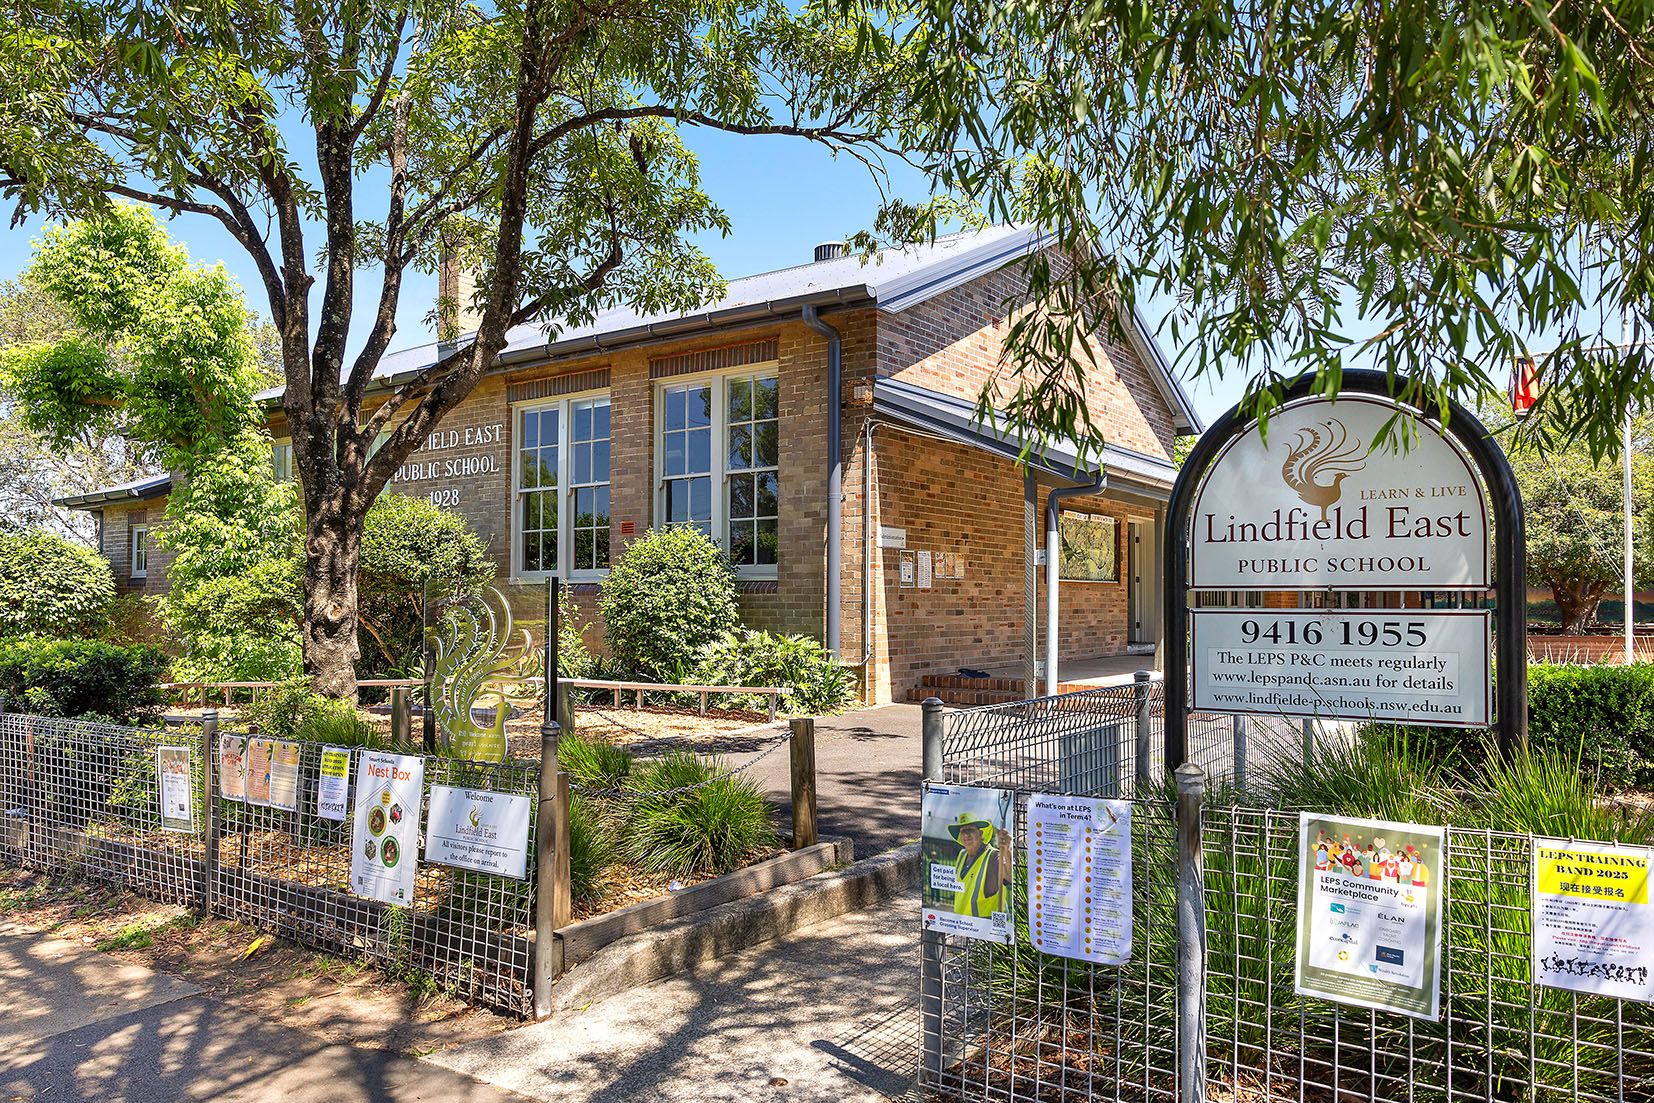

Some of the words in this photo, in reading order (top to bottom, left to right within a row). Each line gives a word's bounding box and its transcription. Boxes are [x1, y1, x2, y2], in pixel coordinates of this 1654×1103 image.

[465, 424, 503, 446] EAST
[395, 461, 440, 482] PUBLIC
[445, 455, 500, 477] SCHOOL
[430, 489, 460, 507] 1928
[1360, 488, 1409, 501] LEARN
[1415, 487, 1425, 498] &
[1431, 486, 1467, 498] LIVE
[1205, 507, 1369, 544] Lindfield
[1386, 506, 1471, 539] East
[1238, 557, 1318, 574] PUBLIC
[1327, 556, 1431, 573] SCHOOL
[1241, 620, 1323, 645] 9416
[1339, 621, 1427, 647] 1955
[1217, 651, 1243, 665] The
[1247, 653, 1285, 667] LEPS
[1290, 653, 1326, 668] P&C
[1330, 655, 1372, 669] meets
[1378, 656, 1447, 673] regularly
[1213, 671, 1371, 689] www.lepspandc.asn.au
[1375, 674, 1398, 688] for
[1402, 675, 1454, 691] details
[1213, 691, 1462, 715] www.lindfielde-p.schools.nsw.edu.au
[367, 764, 389, 779] Nest
[391, 767, 411, 781] Box
[464, 791, 494, 803] Welcome
[1035, 801, 1057, 810] What's
[1074, 805, 1092, 813] LEPS
[1067, 812, 1084, 820] Term
[455, 824, 482, 837] Lindfield
[484, 829, 497, 839] East
[441, 840, 450, 848] All
[450, 842, 467, 850] visitors
[468, 845, 484, 853] please
[485, 849, 501, 857] report
[459, 855, 473, 863] office
[1540, 850, 1574, 861] LEPS
[1576, 853, 1646, 868] TRAINING
[932, 866, 942, 874] Get
[942, 867, 954, 876] paid
[941, 875, 955, 883] being
[1556, 865, 1593, 876] BAND
[1596, 869, 1629, 880] 2025
[937, 881, 949, 889] local
[949, 883, 963, 891] hero.
[1320, 876, 1340, 886] LEPS
[1342, 879, 1399, 897] Community
[1320, 885, 1379, 902] Marketplace
[1560, 881, 1625, 898] 现在接受报名
